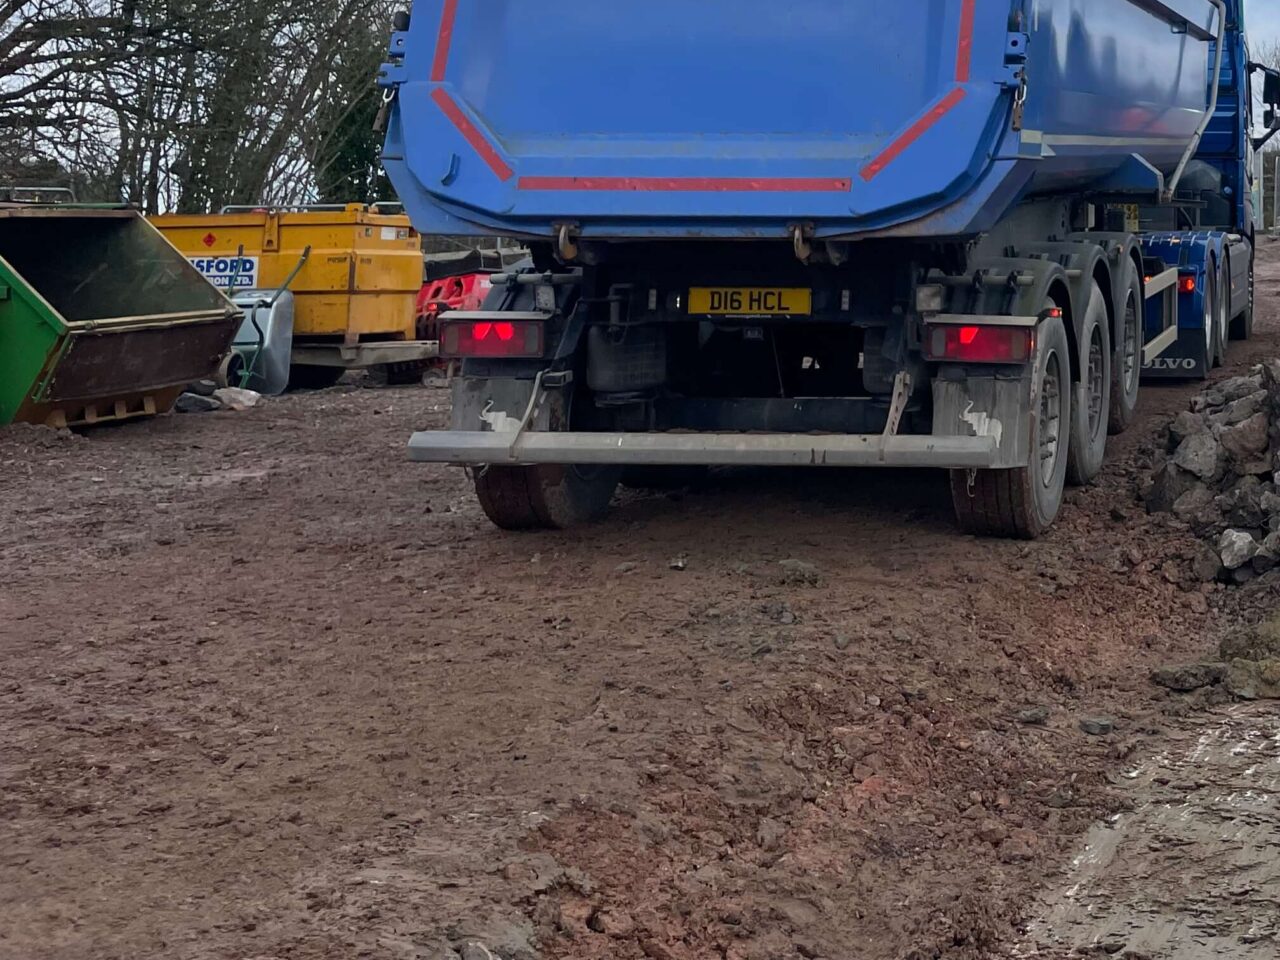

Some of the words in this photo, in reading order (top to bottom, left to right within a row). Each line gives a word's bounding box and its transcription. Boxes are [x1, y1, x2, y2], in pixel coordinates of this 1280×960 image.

[191, 259, 254, 273] SFORD
[709, 291, 742, 310] D16
[748, 291, 790, 311] HCL
